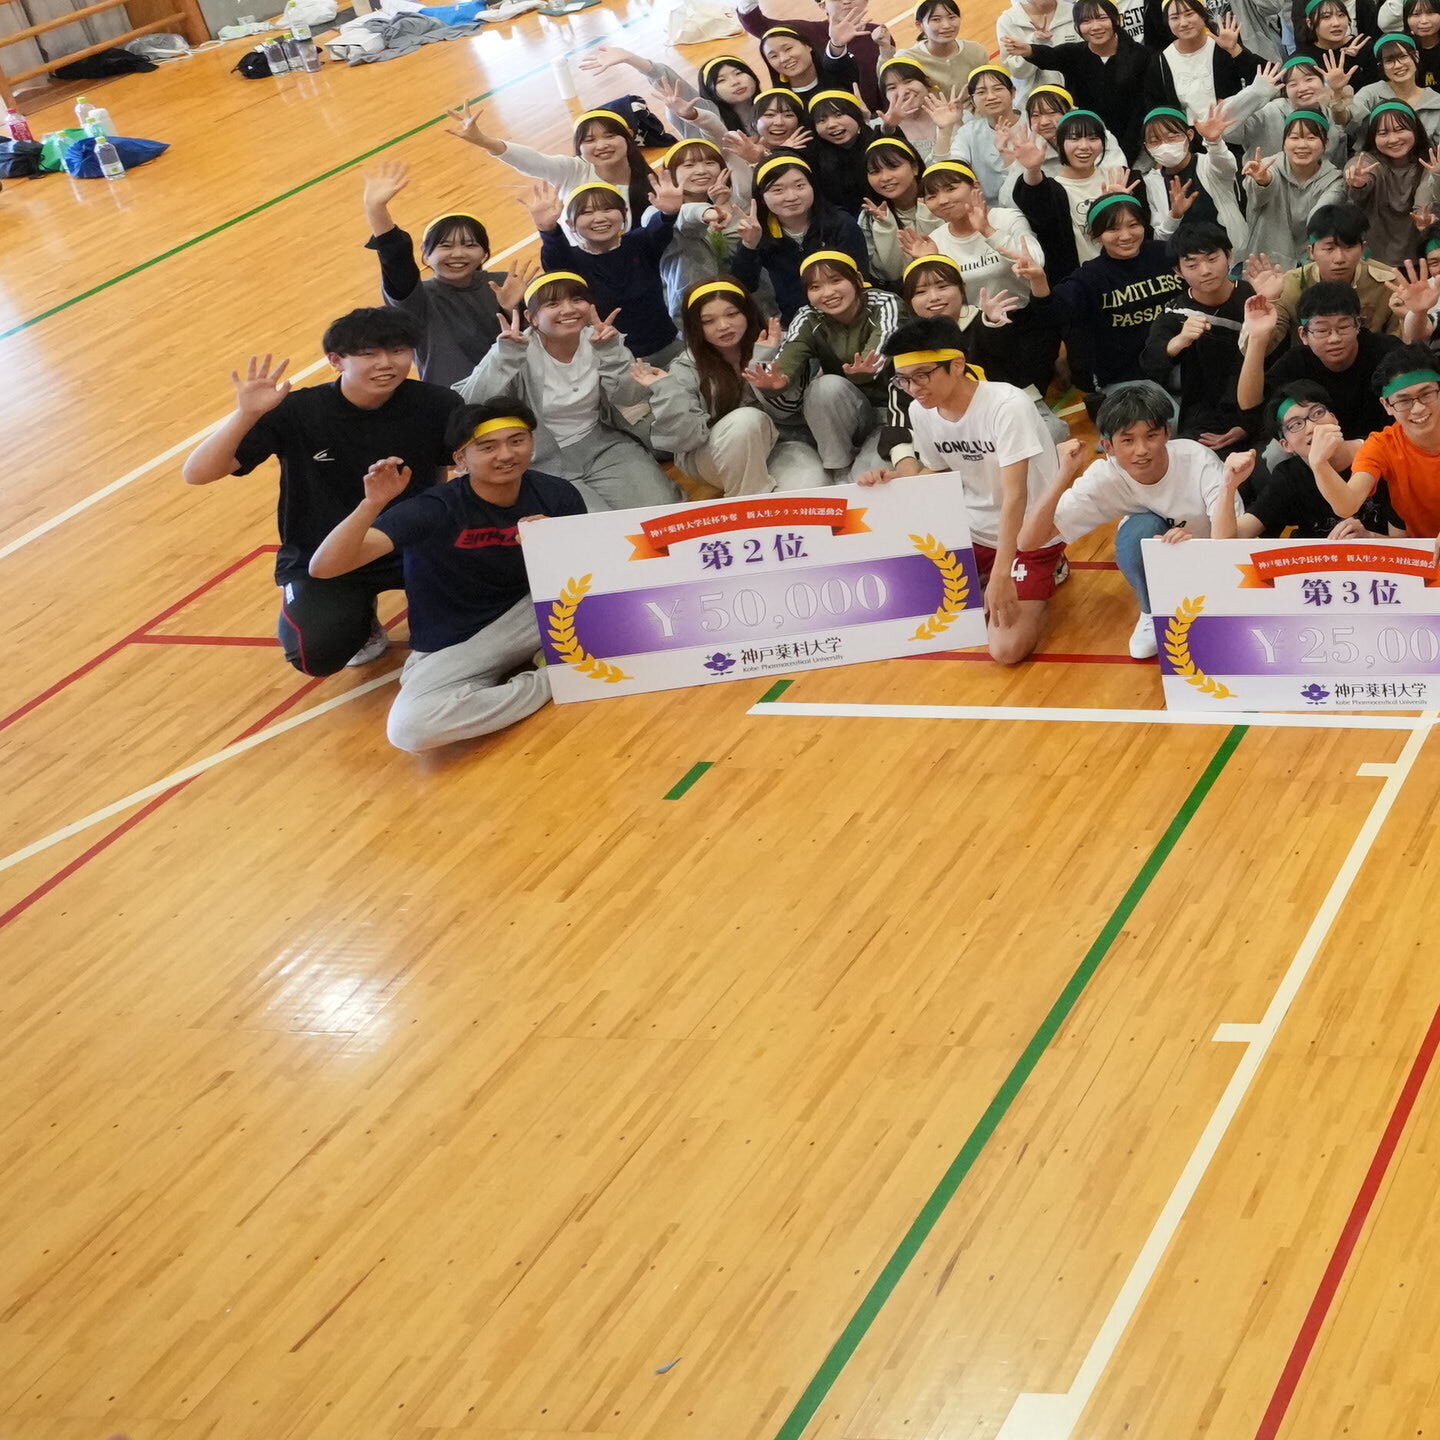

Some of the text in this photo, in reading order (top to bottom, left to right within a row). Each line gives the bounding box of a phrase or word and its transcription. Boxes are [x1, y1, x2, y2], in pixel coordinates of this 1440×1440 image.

[1102, 274, 1183, 310] LIMITLESS
[699, 532, 809, 571] 第2位
[1010, 557, 1027, 582] 4
[1300, 578, 1402, 607] 第3位
[741, 636, 843, 665] 神戸薬科大学
[742, 654, 844, 673] Kobe Pharmaceutical University
[1334, 682, 1427, 698] 神戸薬科大学
